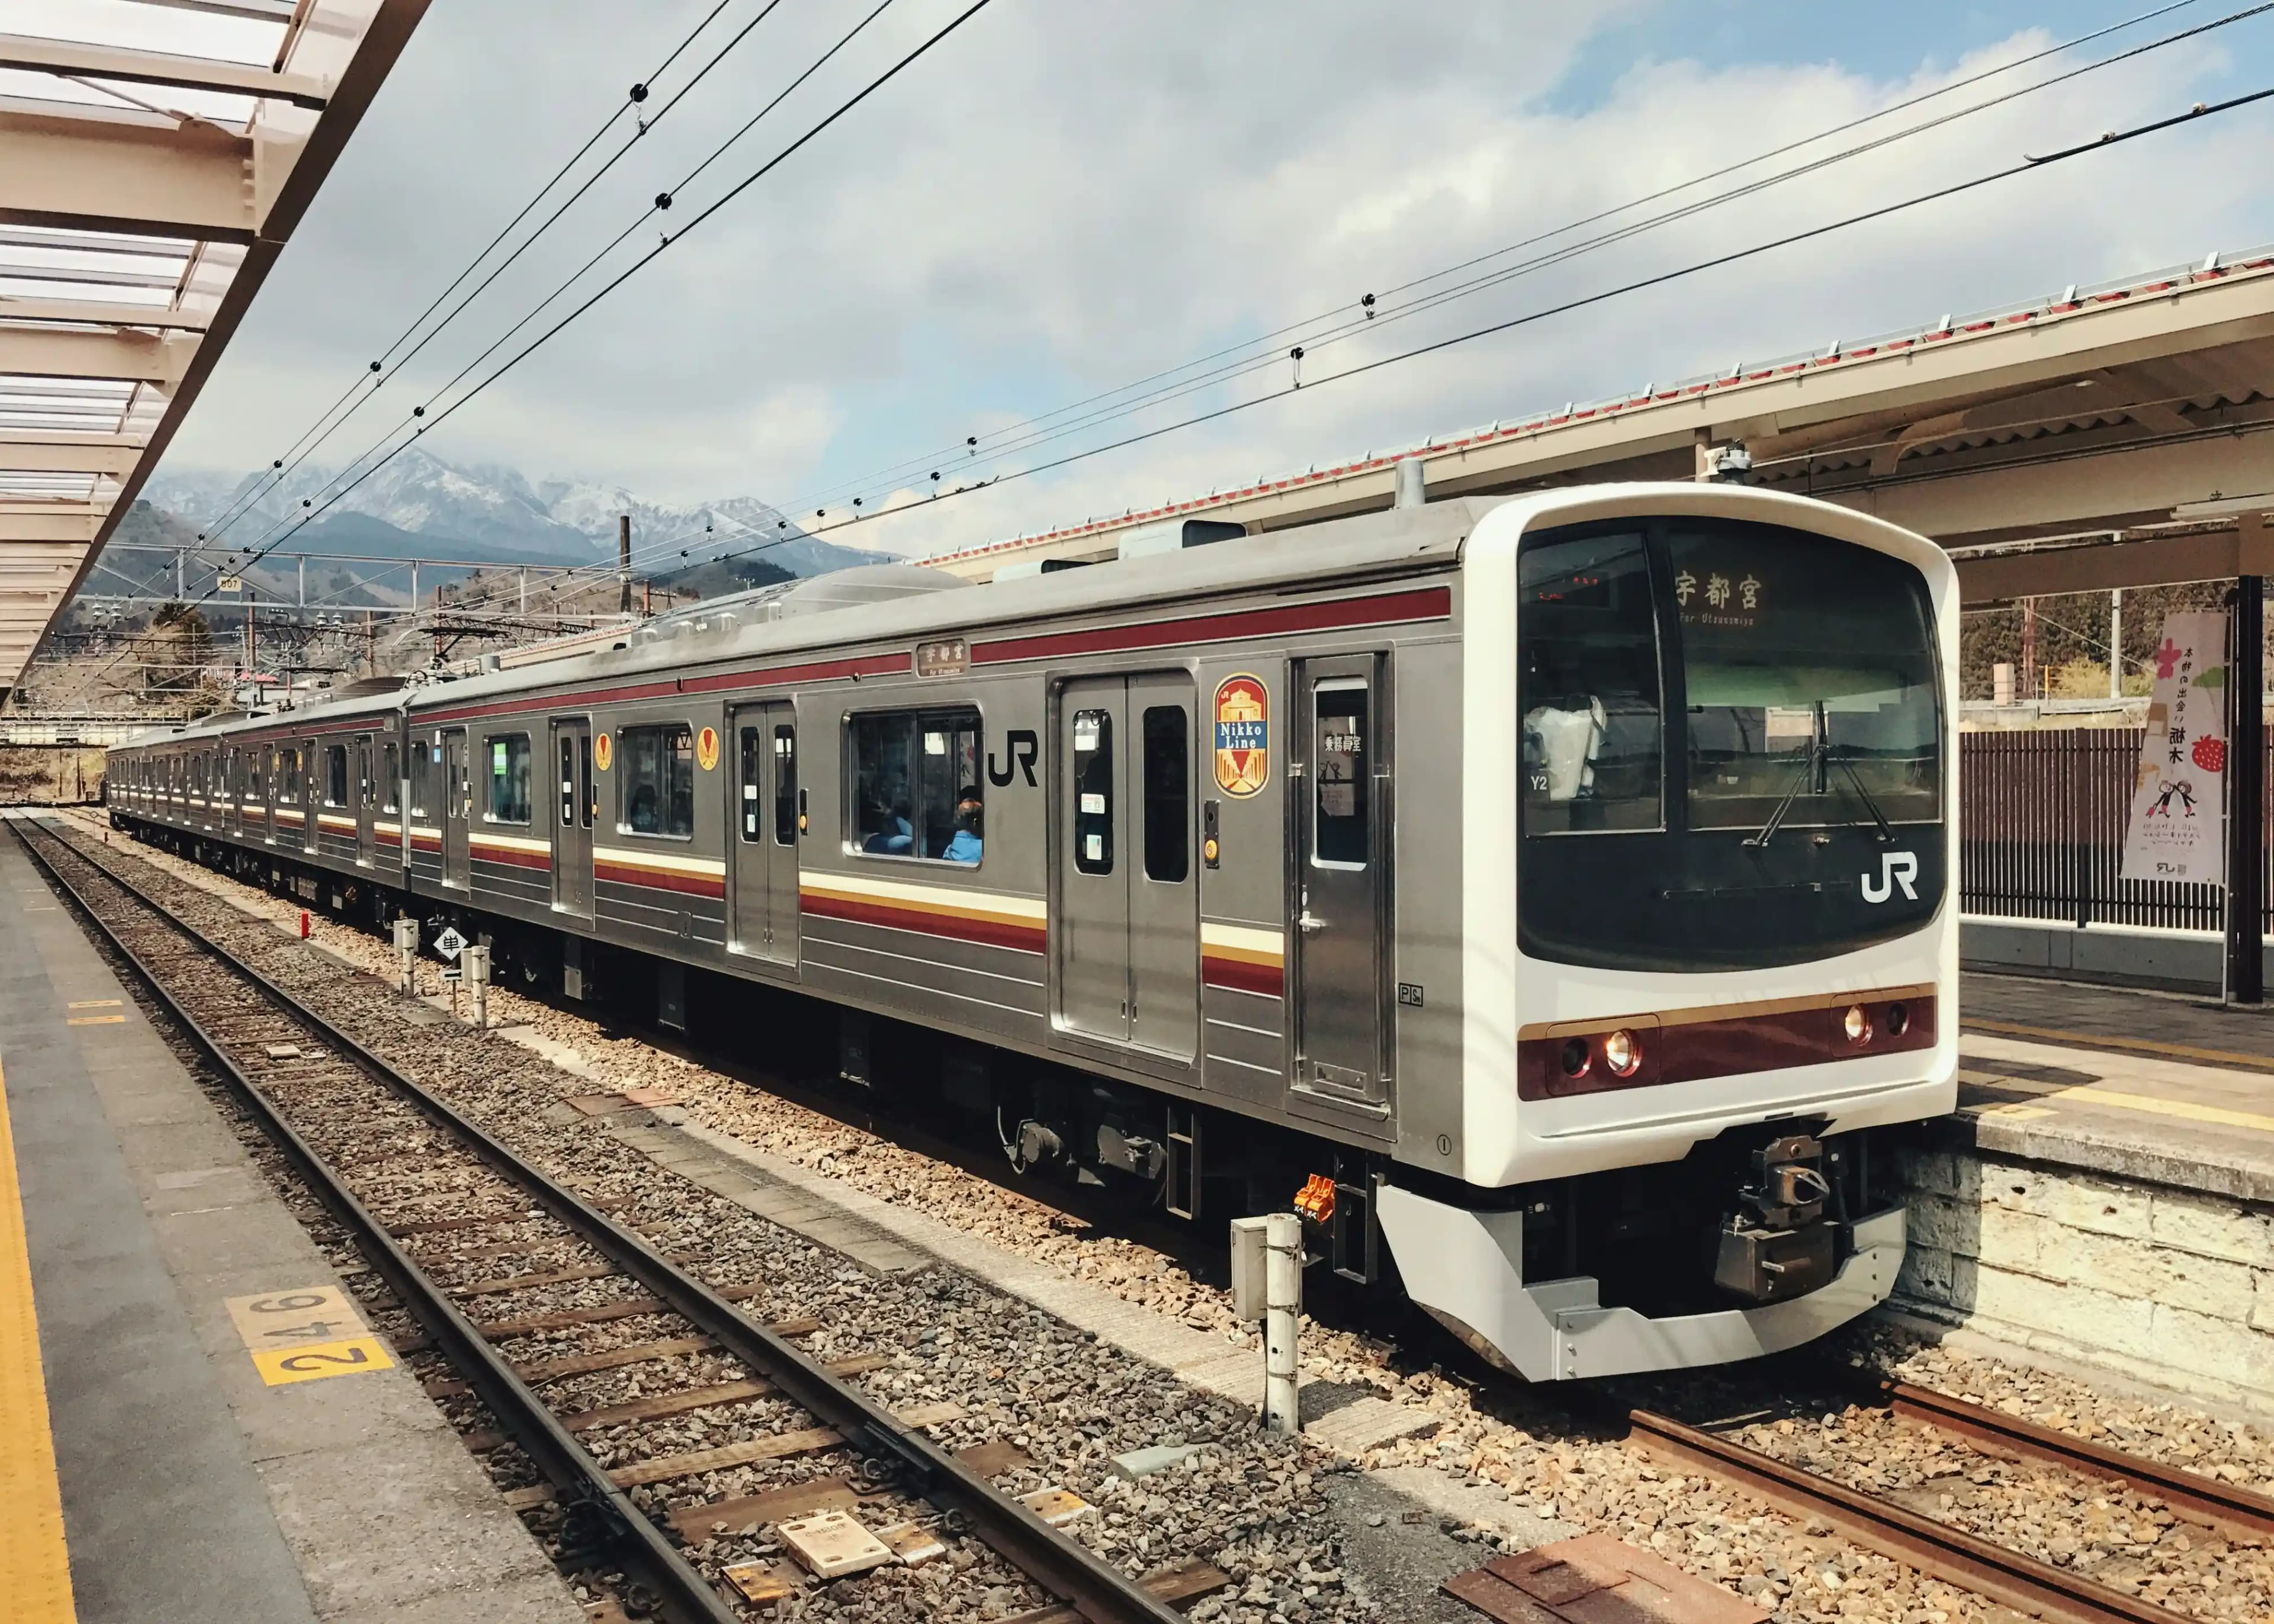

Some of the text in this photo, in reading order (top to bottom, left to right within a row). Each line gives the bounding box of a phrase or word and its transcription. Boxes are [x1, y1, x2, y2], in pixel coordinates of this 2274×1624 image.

[1675, 570, 1762, 610] 宇都宮
[1220, 722, 1262, 736] Nikko
[1226, 735, 1256, 748] Line
[1325, 736, 1361, 752] 乗務員室
[988, 729, 1038, 787] JR
[1530, 776, 1547, 790] Y2
[1861, 851, 1919, 903] JR
[443, 935, 460, 951] 単
